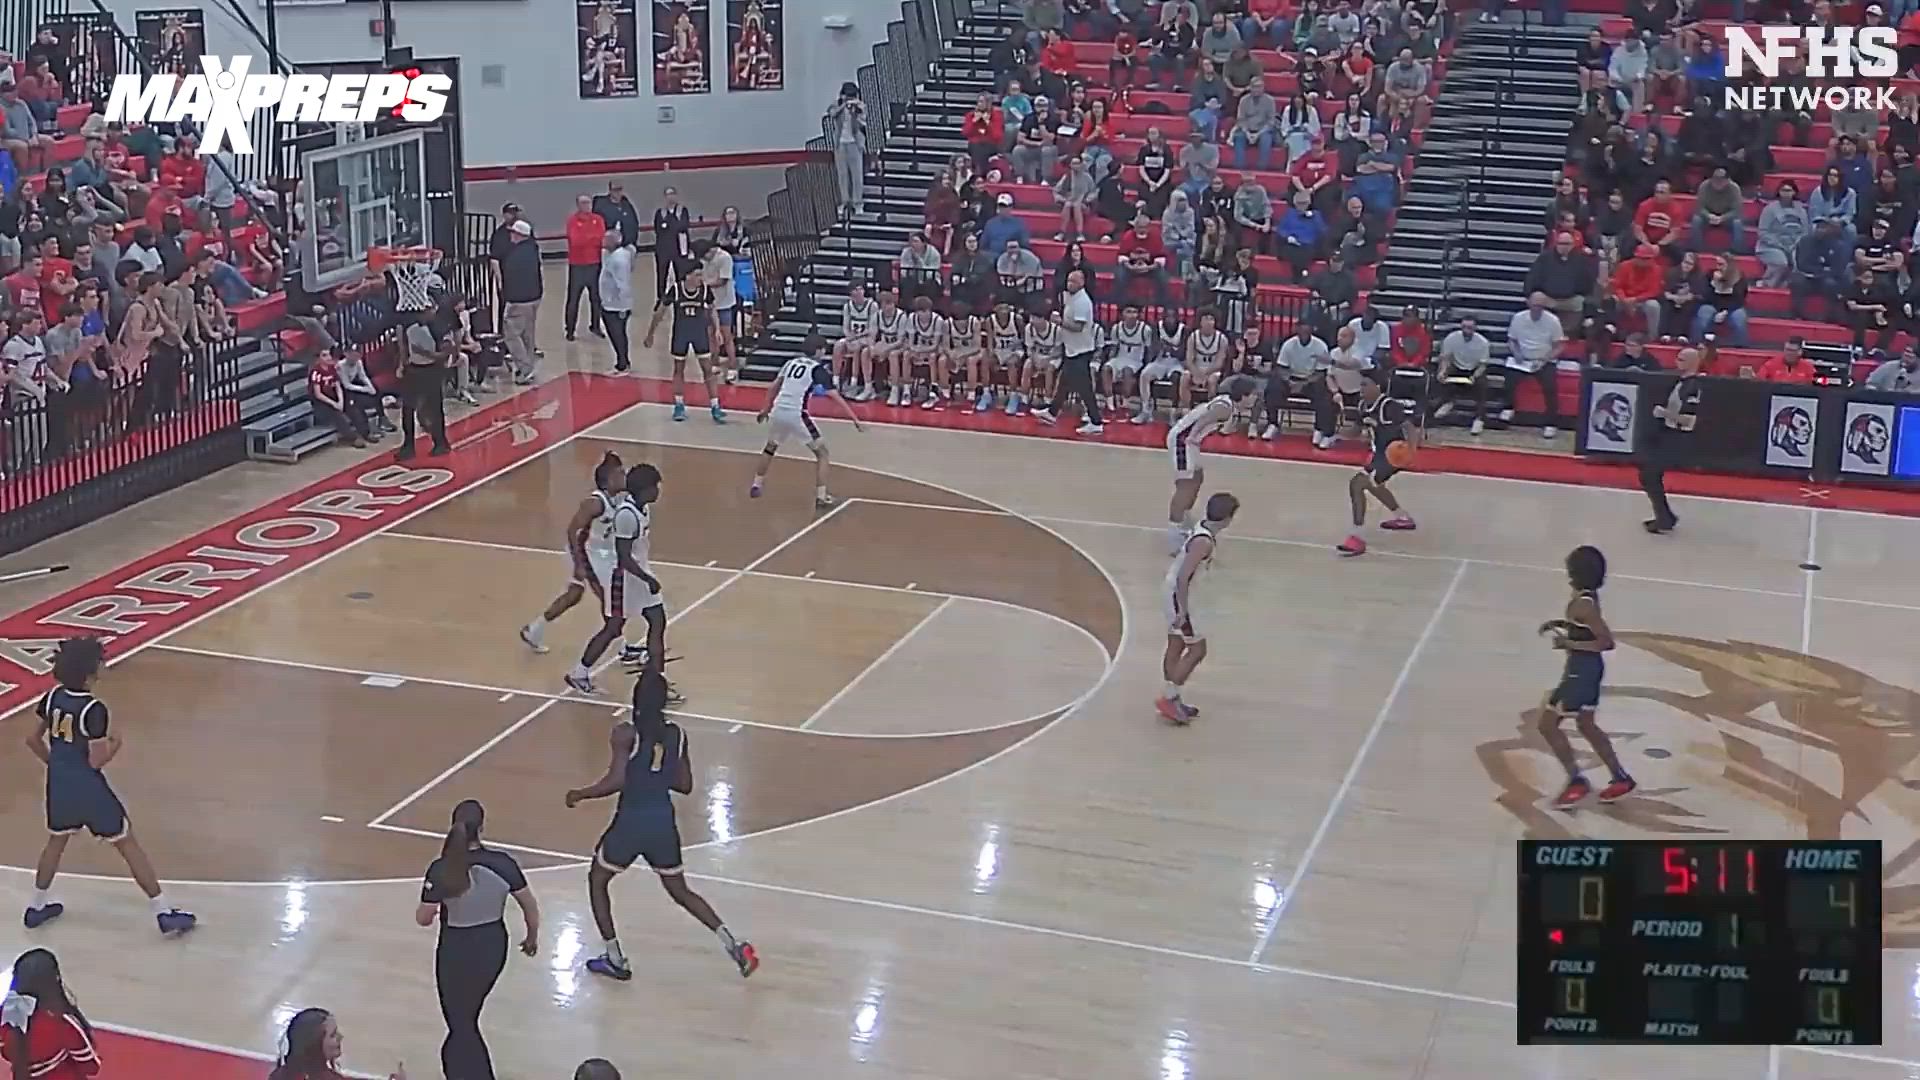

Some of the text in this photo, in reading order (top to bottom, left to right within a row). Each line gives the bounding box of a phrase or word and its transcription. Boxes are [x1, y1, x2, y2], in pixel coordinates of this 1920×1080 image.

[787, 363, 807, 380] 10
[0, 464, 455, 695] ARRIORS
[51, 707, 74, 744] 14
[650, 741, 664, 772] 1
